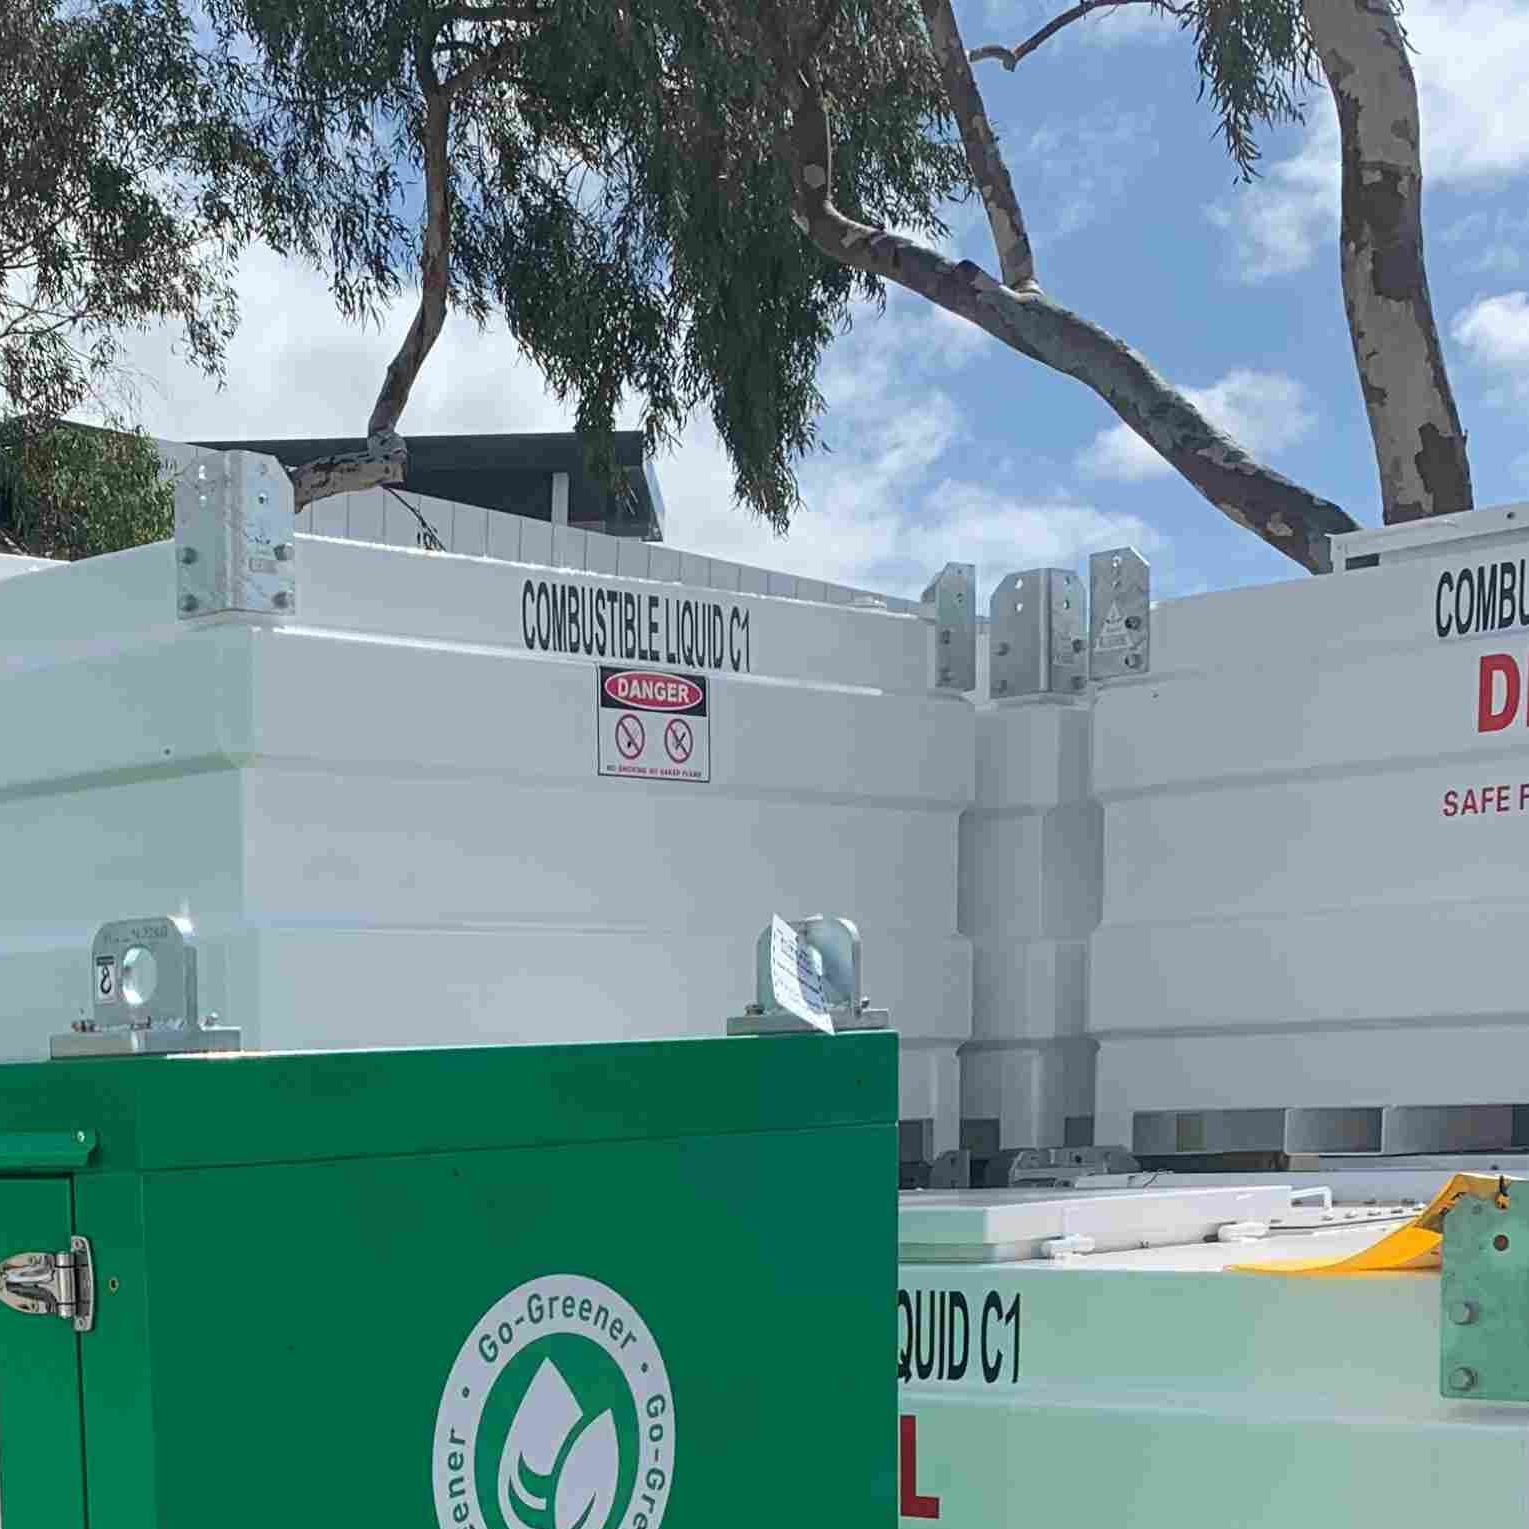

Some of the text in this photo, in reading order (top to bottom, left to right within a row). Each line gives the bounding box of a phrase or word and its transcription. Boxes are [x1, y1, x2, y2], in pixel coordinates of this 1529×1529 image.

[522, 579, 751, 673] COMBUSTIBLE LIQUID C1
[617, 677, 690, 704] DANGER
[1442, 784, 1510, 817] SAFE
[478, 1293, 638, 1363] Go-Greener
[980, 1290, 1021, 1384] C1
